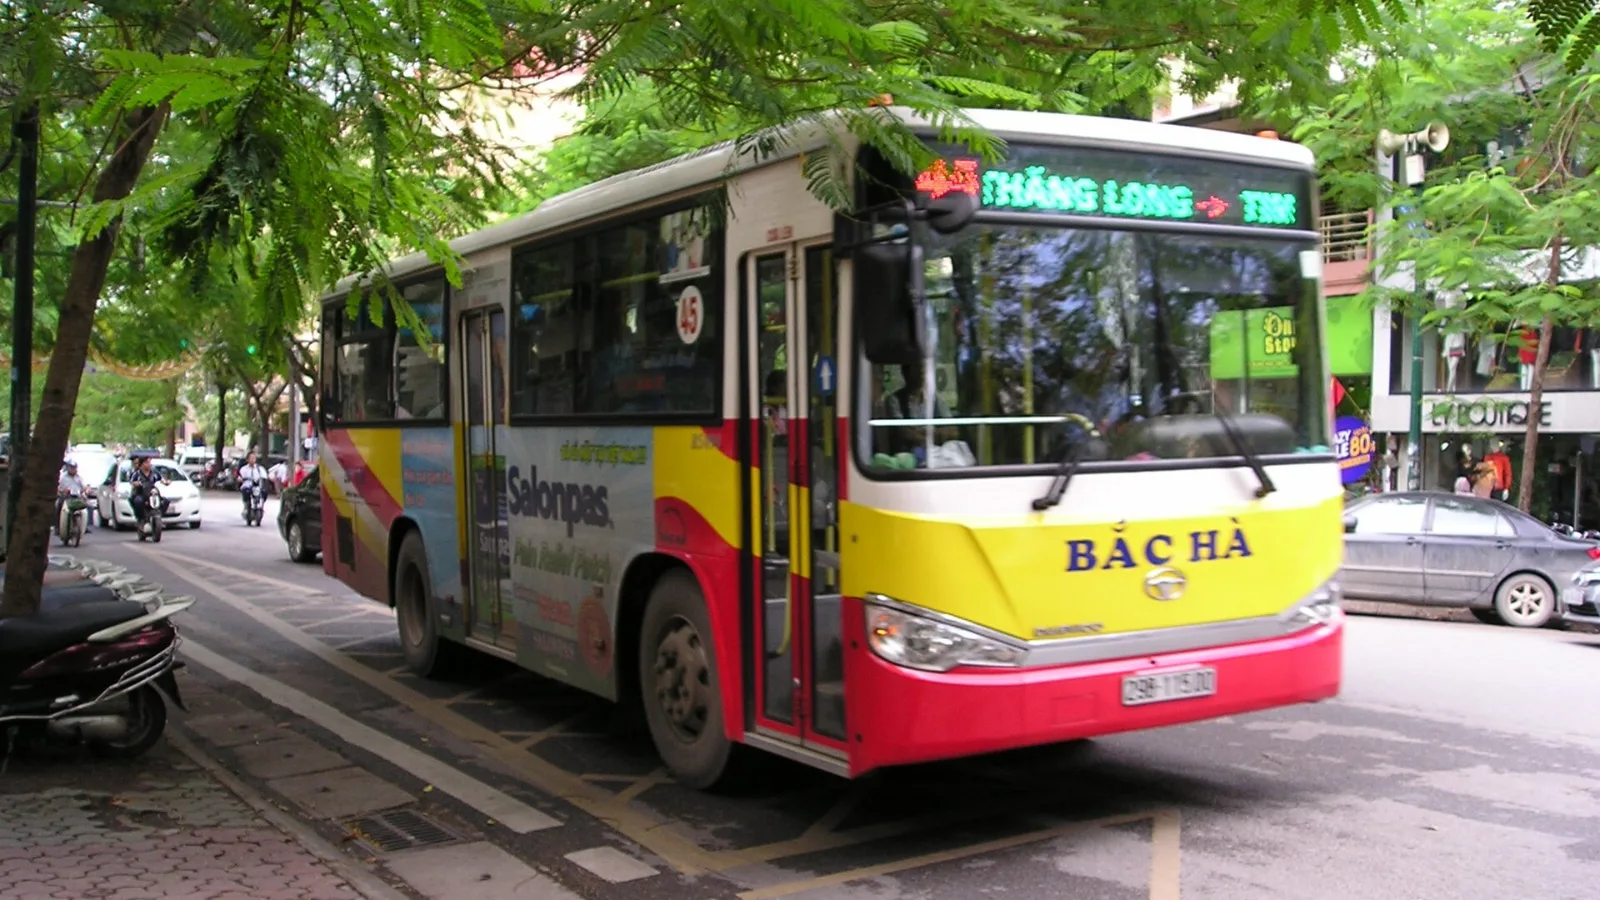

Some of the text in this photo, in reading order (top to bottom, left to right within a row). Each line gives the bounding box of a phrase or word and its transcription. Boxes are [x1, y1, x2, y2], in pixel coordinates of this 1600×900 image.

[1103, 180, 1193, 218] LONG
[680, 296, 698, 335] 45
[1457, 401, 1552, 427] BOUTIQE
[508, 464, 611, 539] Salonpas
[1065, 516, 1253, 572] BẮC HÀ
